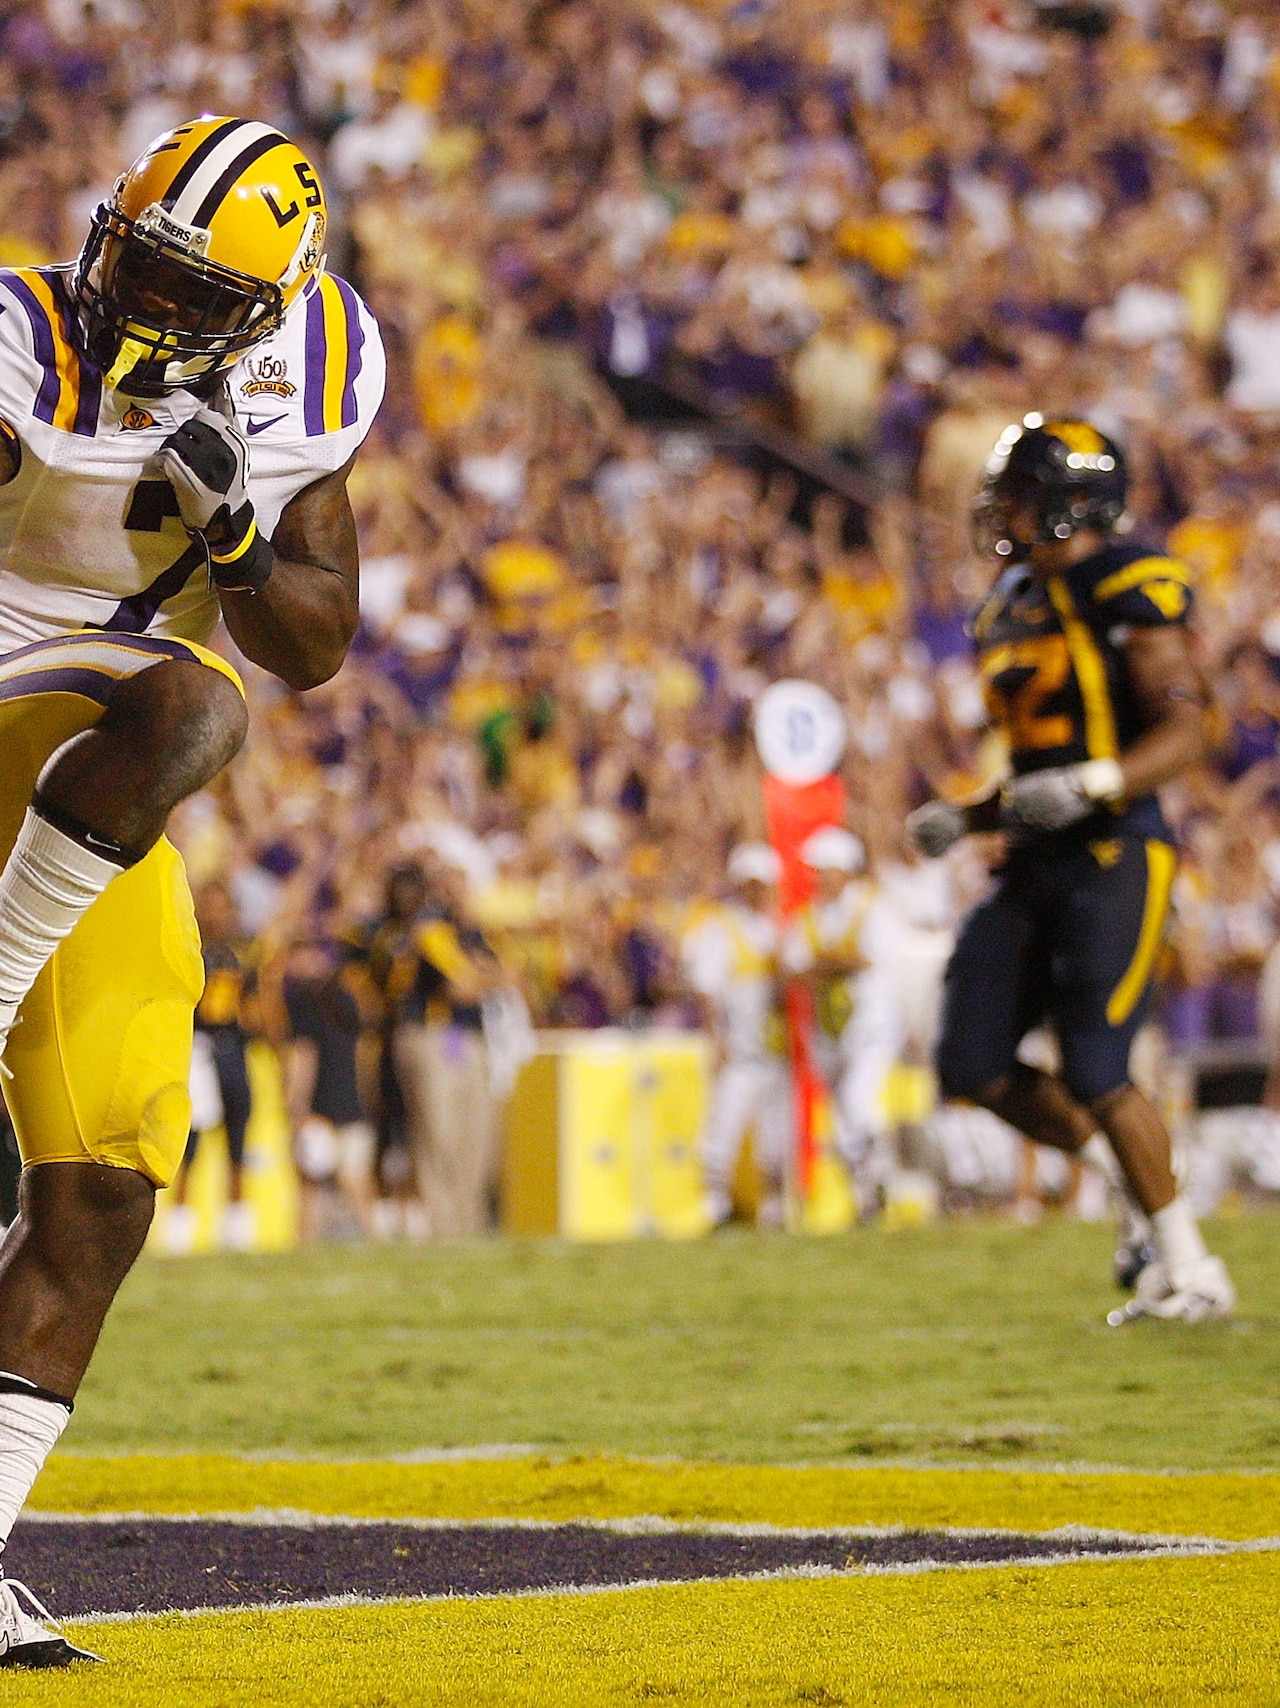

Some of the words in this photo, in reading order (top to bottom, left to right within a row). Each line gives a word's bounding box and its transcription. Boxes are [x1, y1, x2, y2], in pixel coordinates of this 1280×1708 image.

[158, 216, 192, 242] TIGERS
[257, 355, 282, 379] 150
[81, 480, 207, 636] 7
